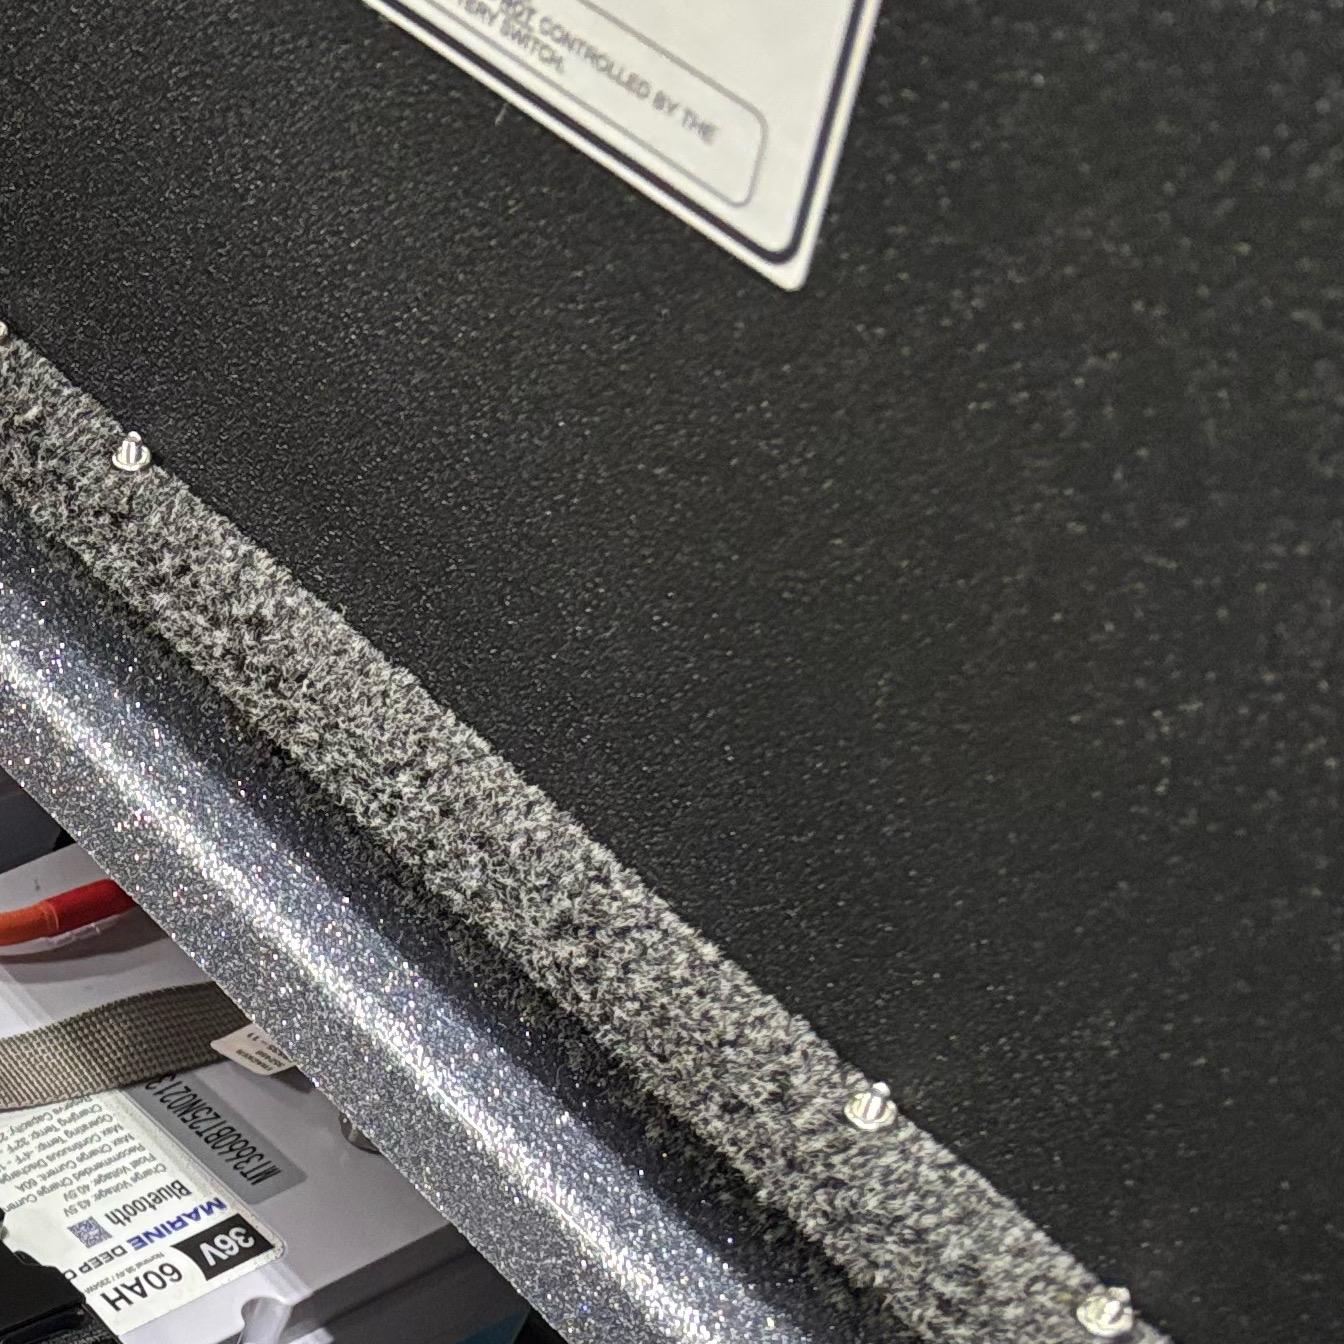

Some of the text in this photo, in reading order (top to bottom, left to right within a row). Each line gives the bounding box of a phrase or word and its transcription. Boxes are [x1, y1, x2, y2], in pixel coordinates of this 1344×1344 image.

[539, 16, 719, 144] CONTROLLED BY THE
[57, 1102, 102, 1126] Charging
[63, 1112, 112, 1138] Operating
[99, 1122, 123, 1136] Max
[46, 1133, 100, 1161] Continuous
[74, 1142, 111, 1163] Charge
[110, 1133, 134, 1146] Max
[34, 1143, 143, 1197] Recommended Charge
[105, 1180, 189, 1227] Bluetooth
[77, 1198, 224, 1273] MARINE DEEP
[201, 1226, 256, 1265] 36V
[102, 1261, 183, 1310] 60AH
